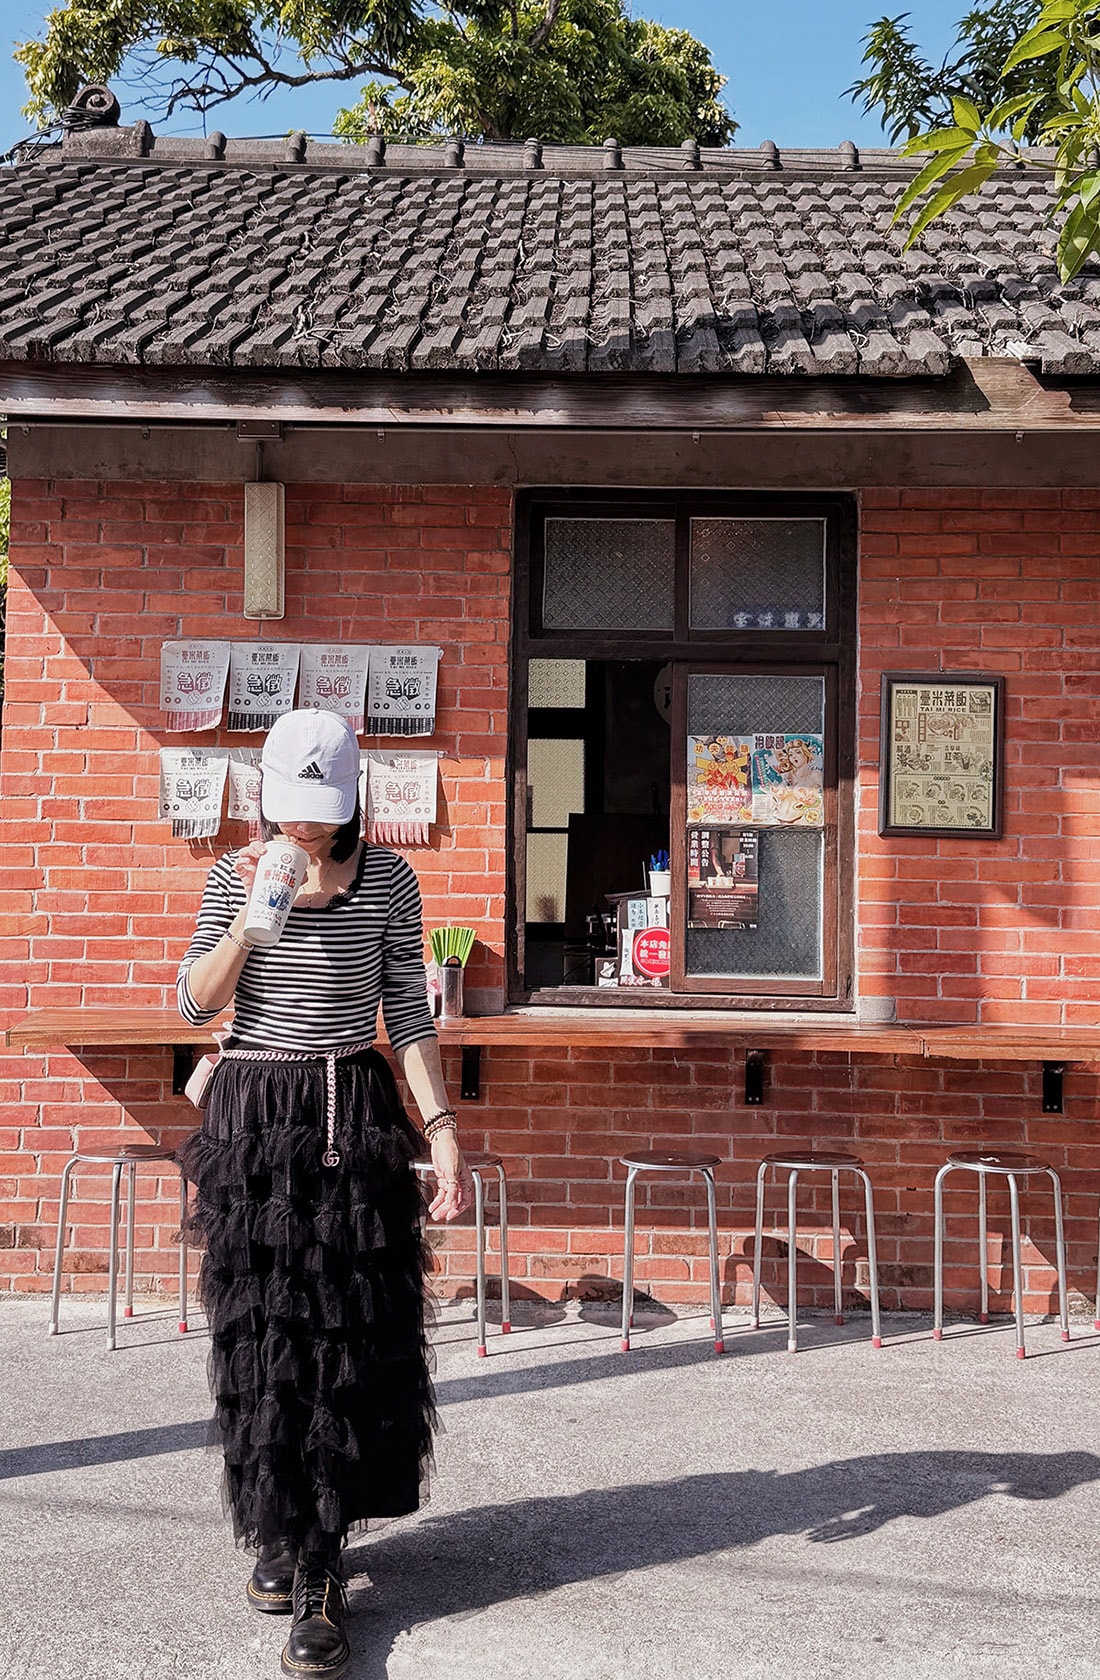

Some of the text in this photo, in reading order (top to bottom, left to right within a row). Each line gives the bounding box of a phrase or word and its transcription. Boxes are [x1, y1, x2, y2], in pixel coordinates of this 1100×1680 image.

[920, 690, 967, 707] 臺米菜飯
[640, 939, 670, 949] 本店免
[640, 949, 670, 959] 統一發
